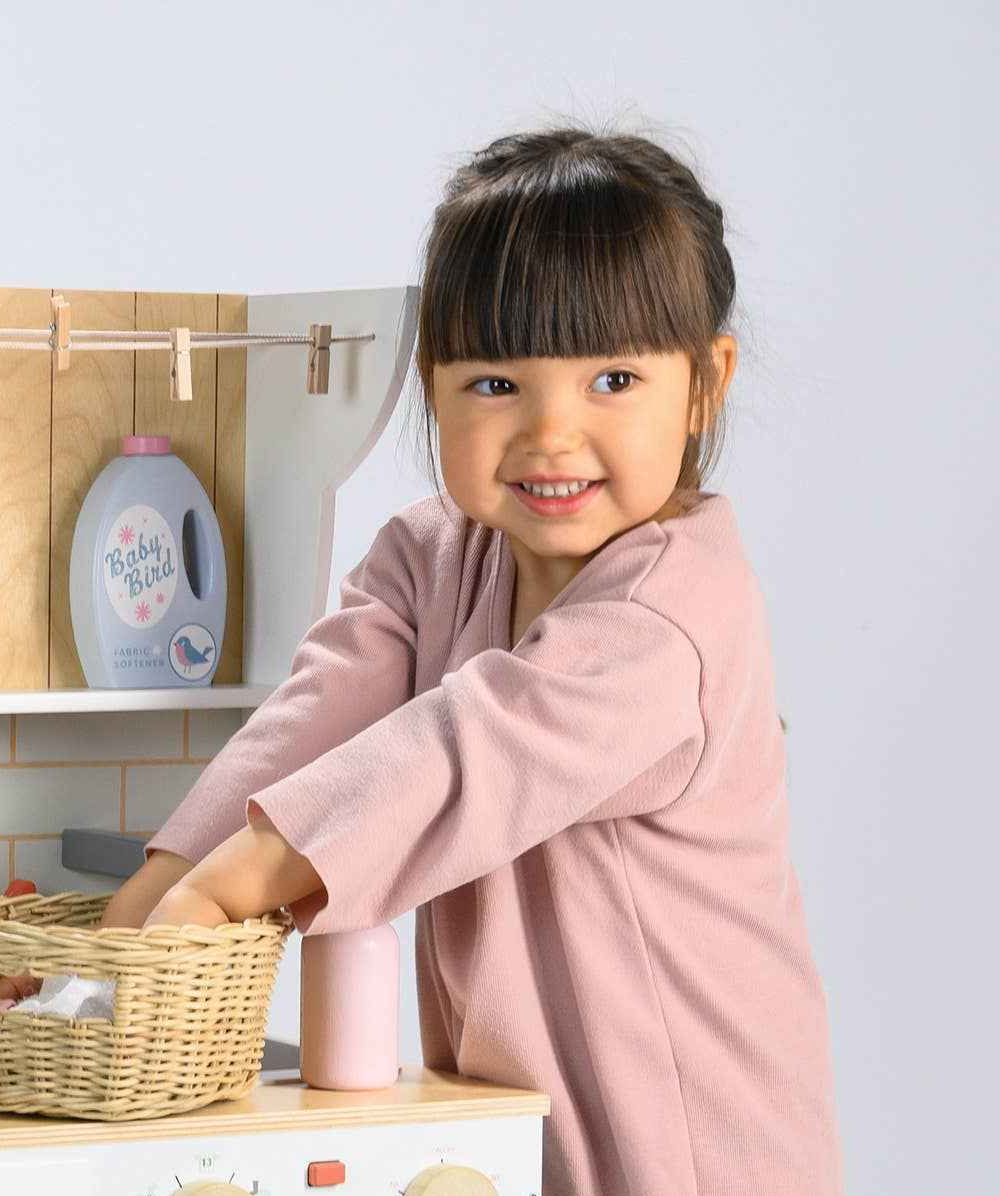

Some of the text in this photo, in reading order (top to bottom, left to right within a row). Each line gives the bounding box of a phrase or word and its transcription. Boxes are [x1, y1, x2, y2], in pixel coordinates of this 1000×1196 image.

[105, 533, 162, 579] Baby
[123, 548, 175, 600] Bird
[114, 647, 150, 657] FABRIC
[114, 659, 165, 669] SOFTENER
